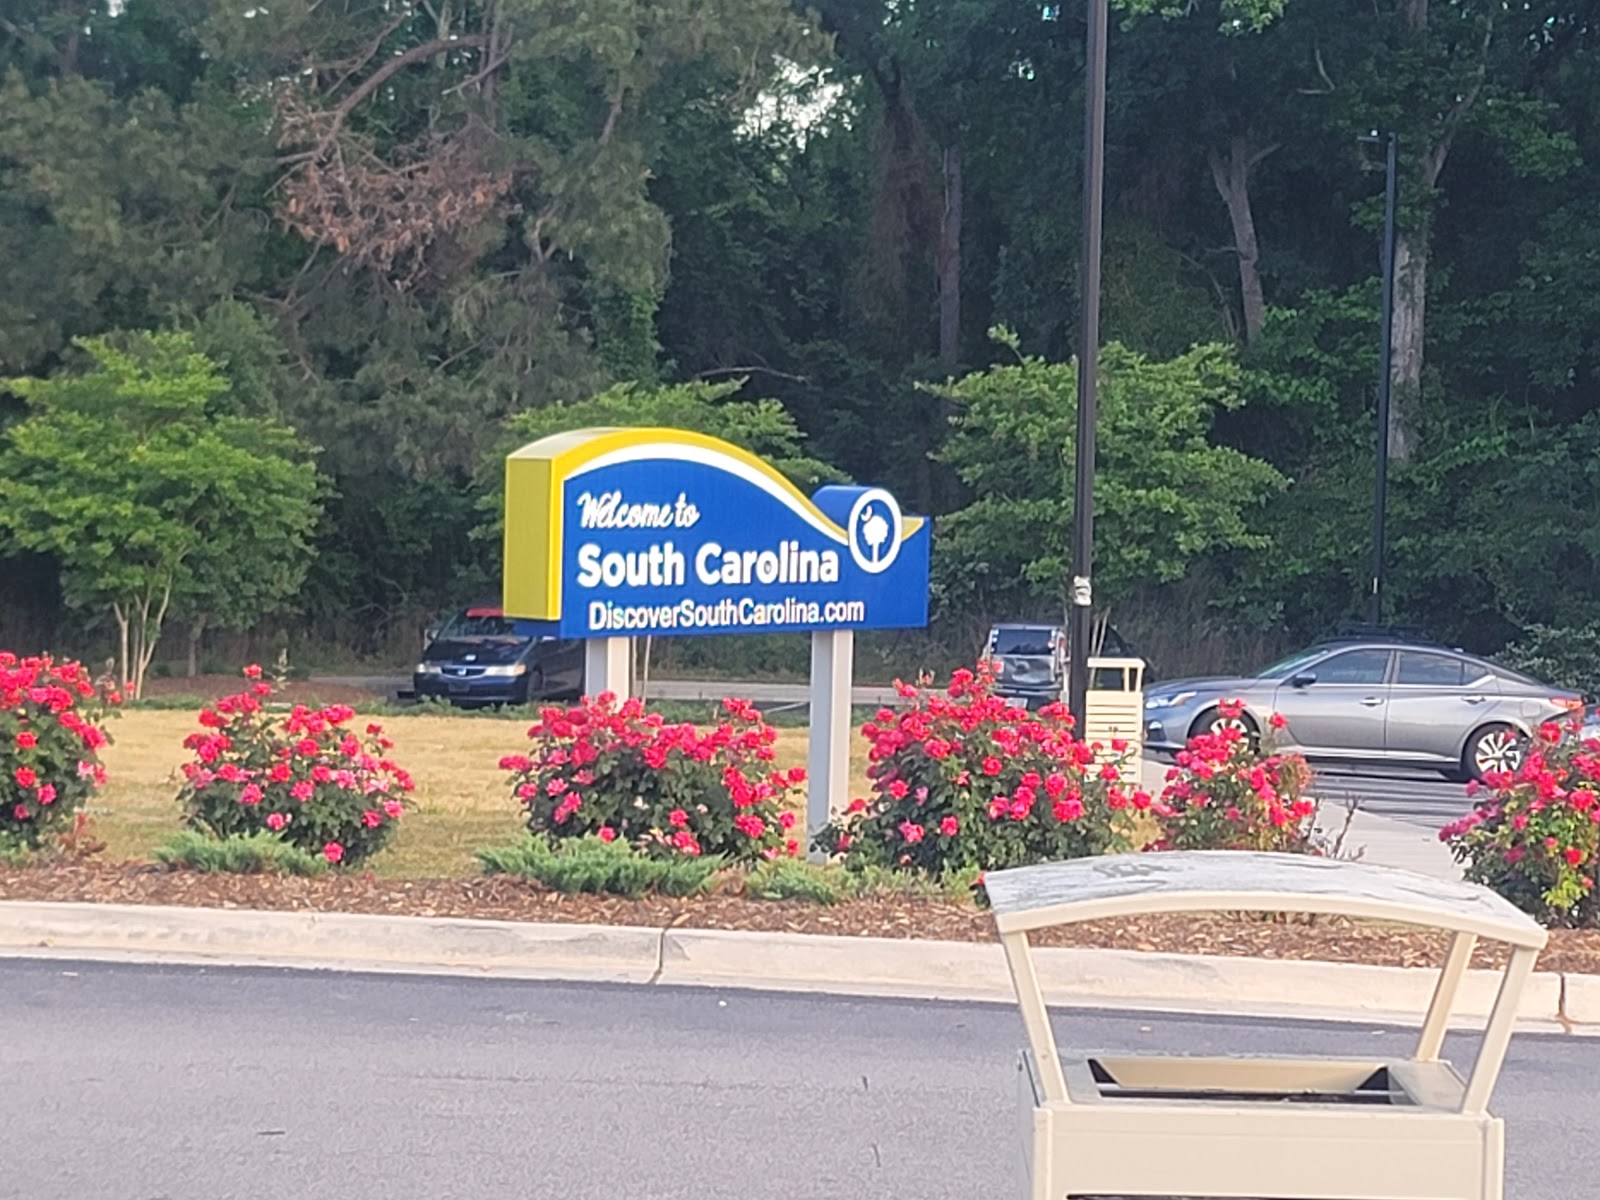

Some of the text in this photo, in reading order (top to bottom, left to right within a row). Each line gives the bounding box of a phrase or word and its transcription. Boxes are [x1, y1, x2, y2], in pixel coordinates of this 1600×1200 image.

[577, 489, 700, 529] Welcome to
[577, 540, 839, 588] South Carolina
[588, 598, 865, 631] DiscoverSouthCarolina.com
